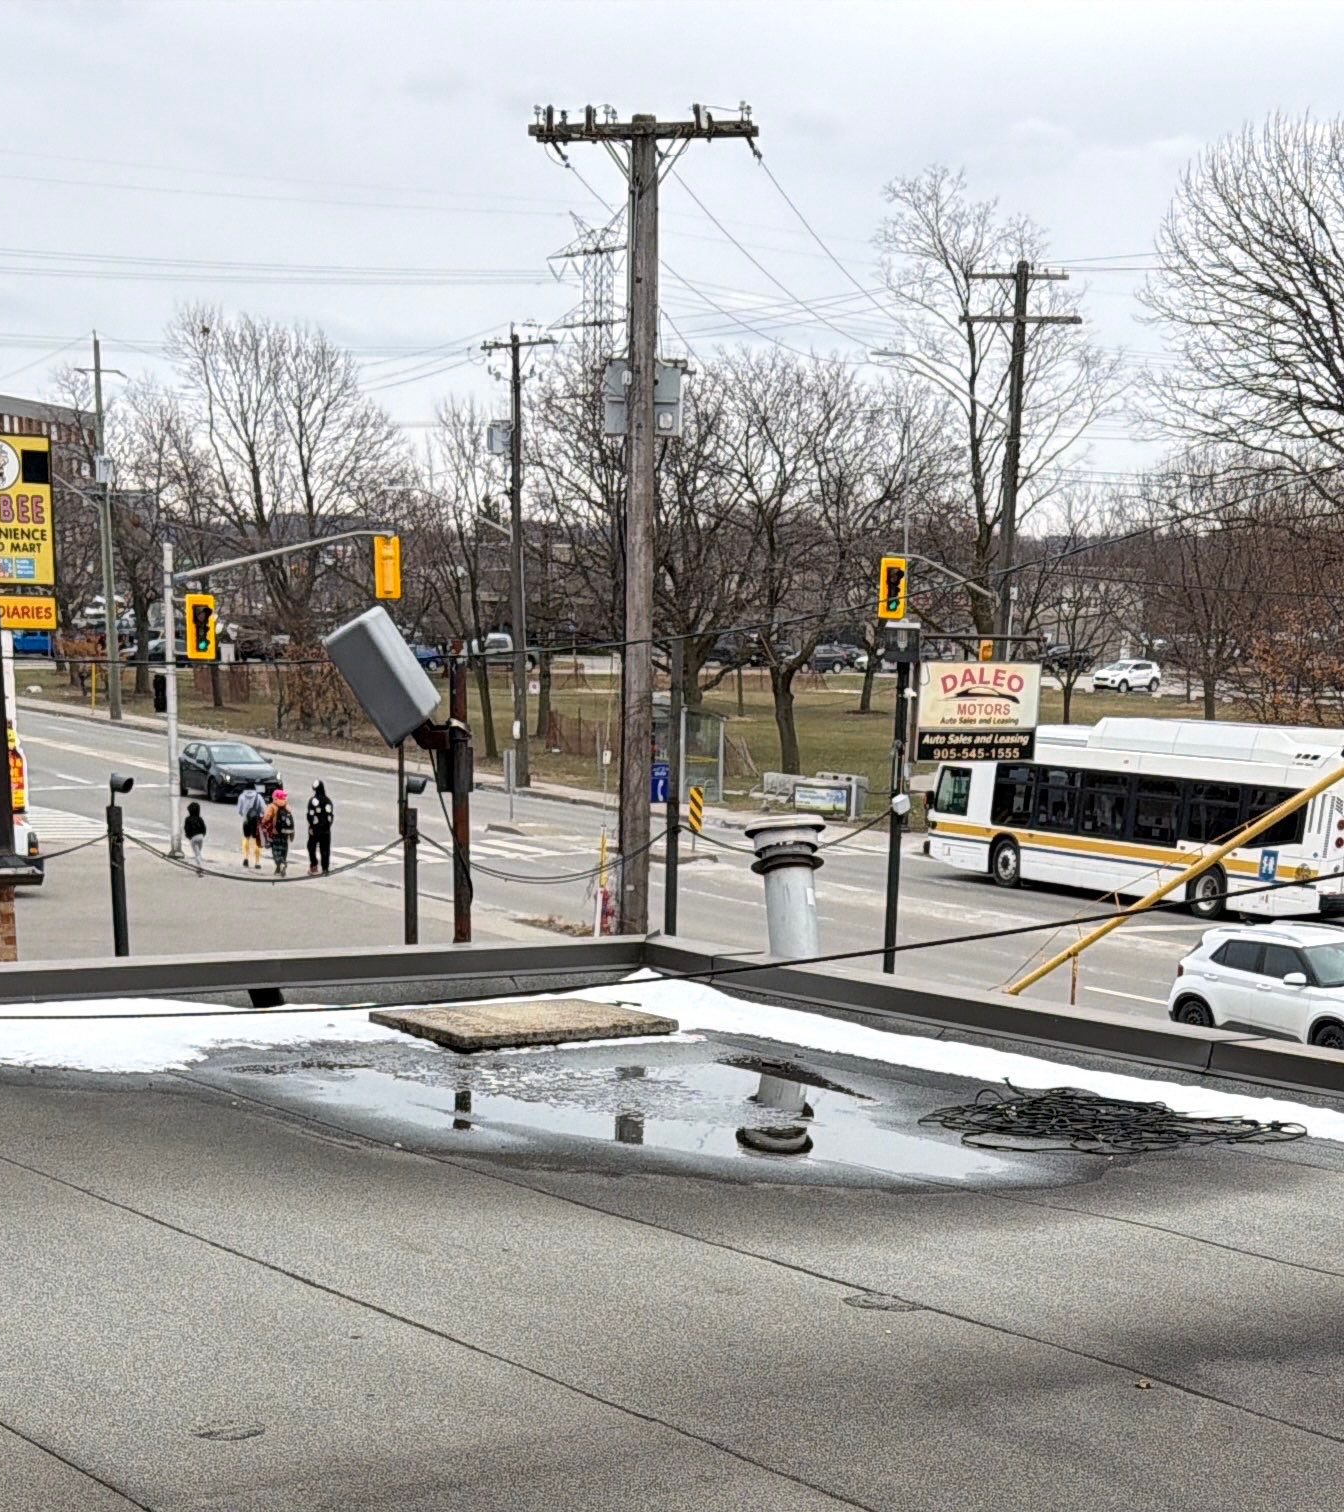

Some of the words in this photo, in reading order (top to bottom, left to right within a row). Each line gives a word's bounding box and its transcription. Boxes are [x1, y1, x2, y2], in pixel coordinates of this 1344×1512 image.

[10, 542, 42, 553] MART
[941, 667, 1024, 694] DALEO
[957, 703, 1011, 716] MOTORS
[940, 717, 956, 725] Auto
[958, 717, 977, 725] Sales
[978, 717, 992, 725] and
[993, 717, 1020, 726] Leasing
[922, 734, 946, 745] Auto
[947, 734, 973, 745] Sales
[974, 734, 993, 744] and
[995, 734, 1030, 746] Leasing
[933, 748, 1020, 759] 905-545-1555
